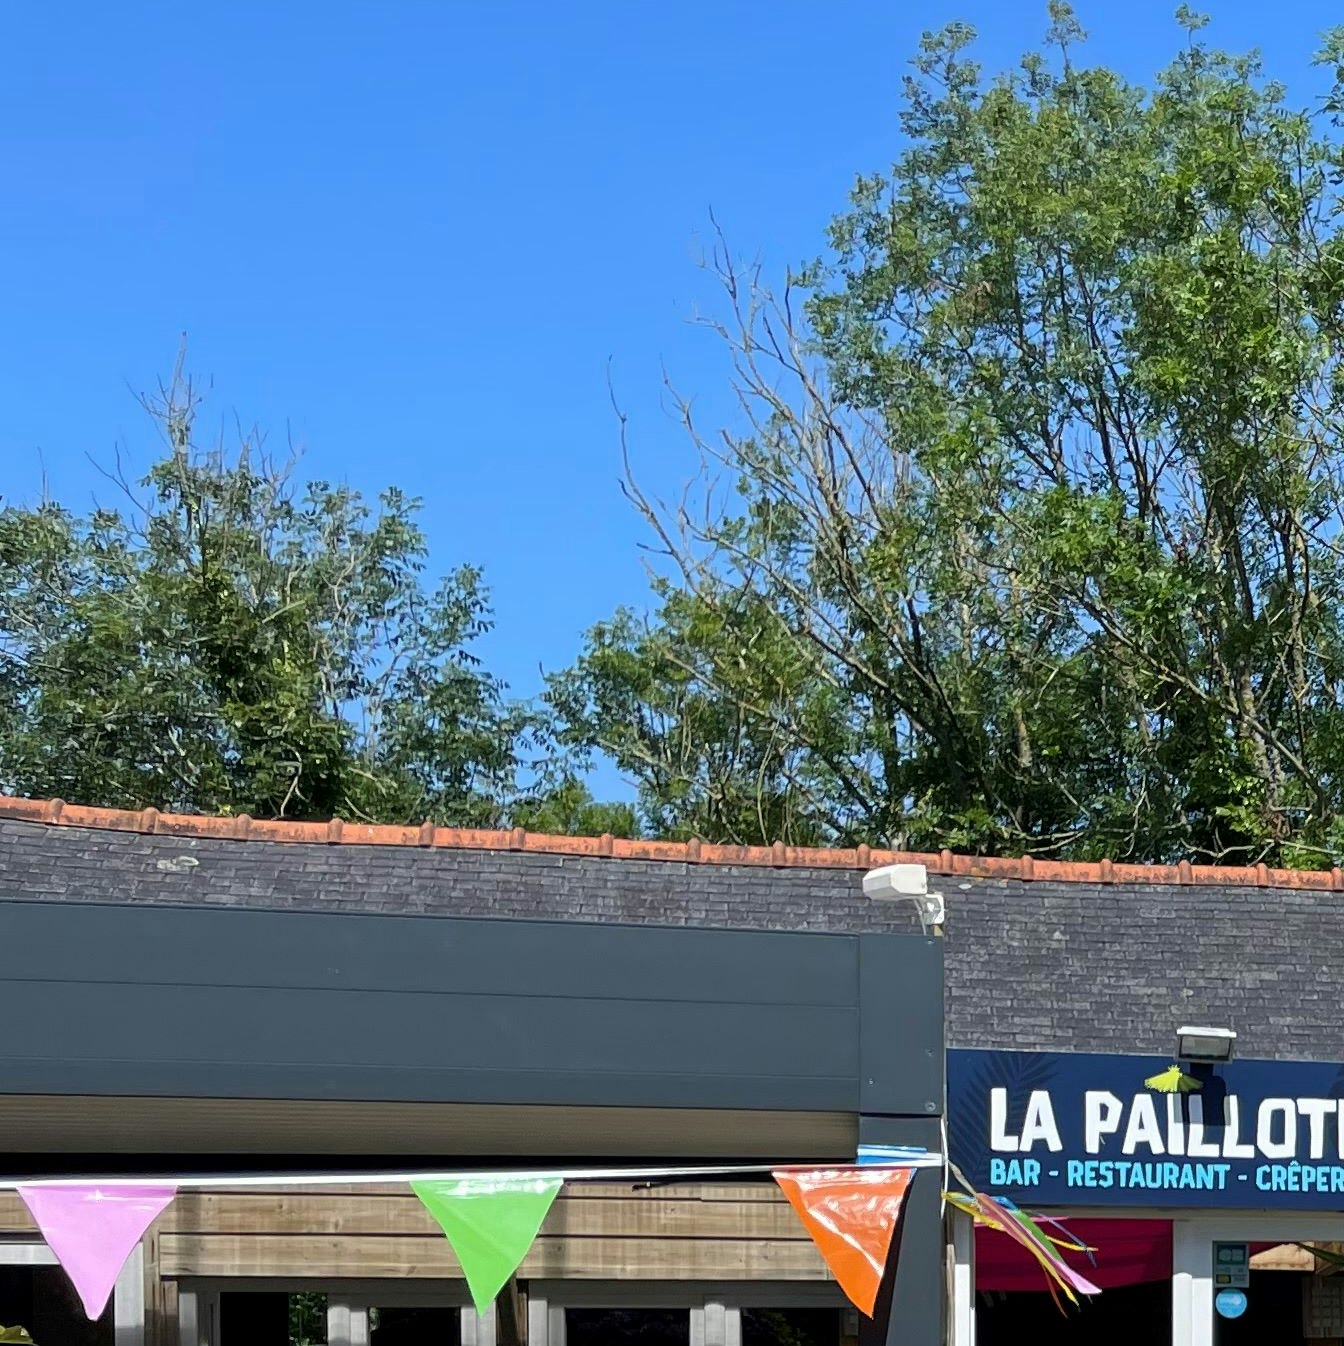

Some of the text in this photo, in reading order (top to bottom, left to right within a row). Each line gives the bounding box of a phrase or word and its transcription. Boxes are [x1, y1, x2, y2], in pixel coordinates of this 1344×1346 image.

[990, 1087, 1063, 1152] LA
[990, 1158, 1041, 1186] BAR
[1067, 1159, 1231, 1190] RESTAURANT
